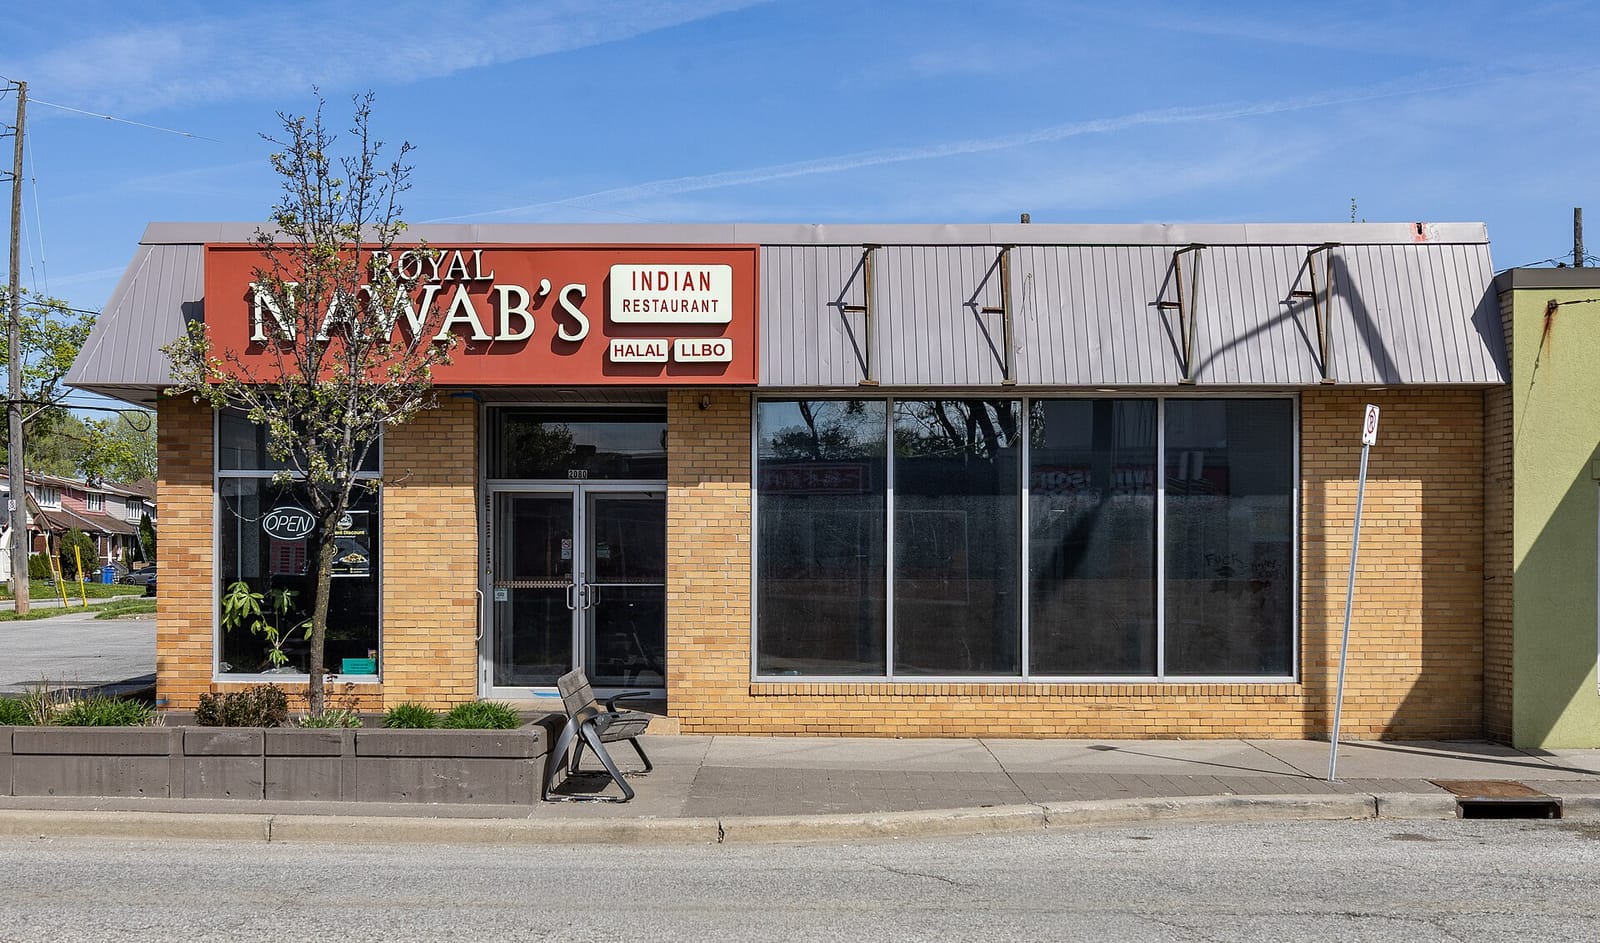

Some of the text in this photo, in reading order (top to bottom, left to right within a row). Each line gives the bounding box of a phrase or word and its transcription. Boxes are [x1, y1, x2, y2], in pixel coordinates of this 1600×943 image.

[372, 249, 494, 281] ROYAL
[632, 271, 711, 291] INDIAN
[249, 278, 590, 342] NAWAB'S
[623, 299, 719, 313] RESTAURANT
[614, 344, 665, 357] HALAL
[681, 343, 726, 357] LLBO
[568, 470, 588, 479] 2080
[265, 515, 311, 532] OPEN
